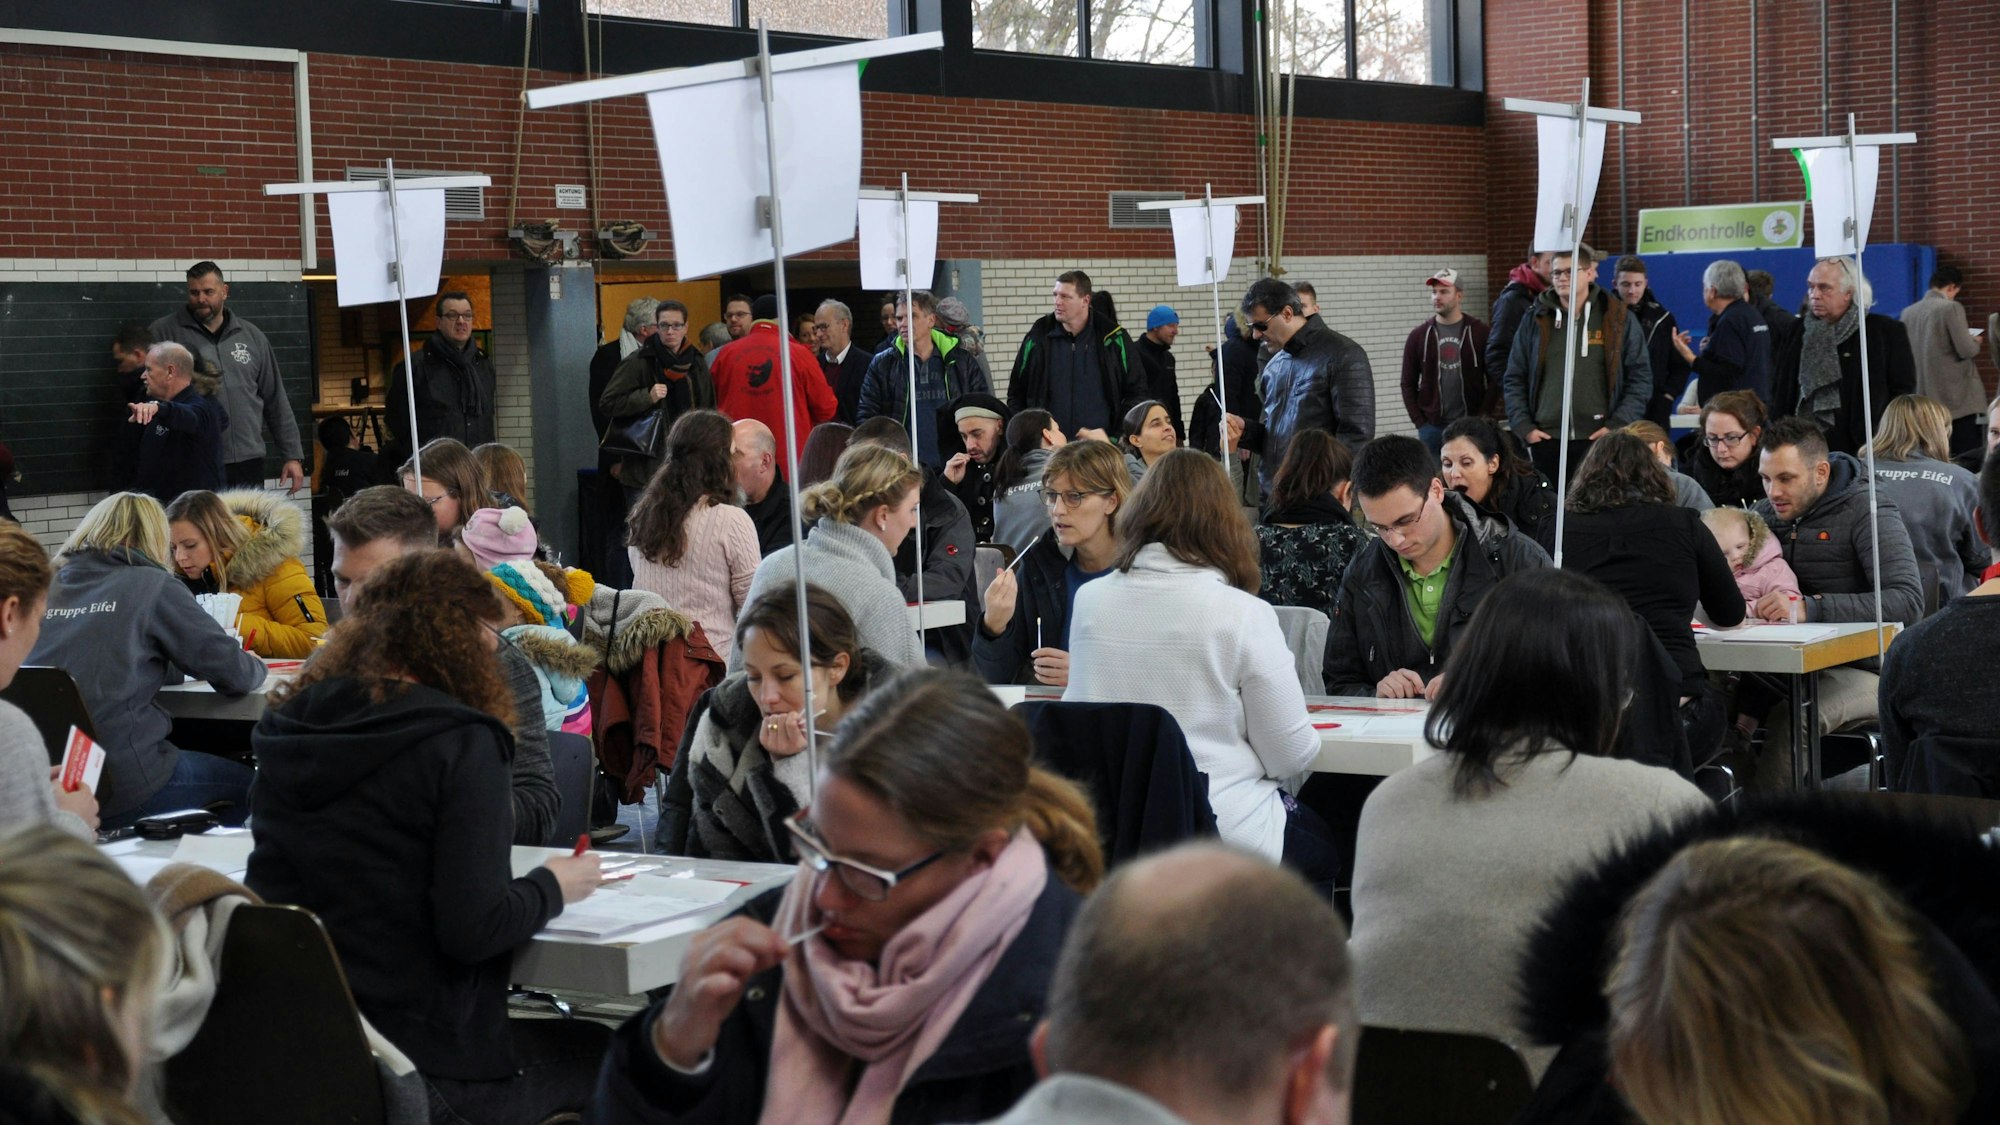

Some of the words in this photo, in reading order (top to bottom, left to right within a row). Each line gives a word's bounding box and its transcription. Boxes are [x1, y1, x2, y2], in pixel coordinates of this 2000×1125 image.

[1643, 222, 1756, 244] Endkontrolle
[916, 390, 946, 400] ENIM
[1876, 470, 1918, 481] ruppe
[1921, 470, 1954, 486] Eifel
[1005, 480, 1043, 496] gruppe
[45, 607, 87, 619] gruppe
[89, 601, 117, 613] Eifel
